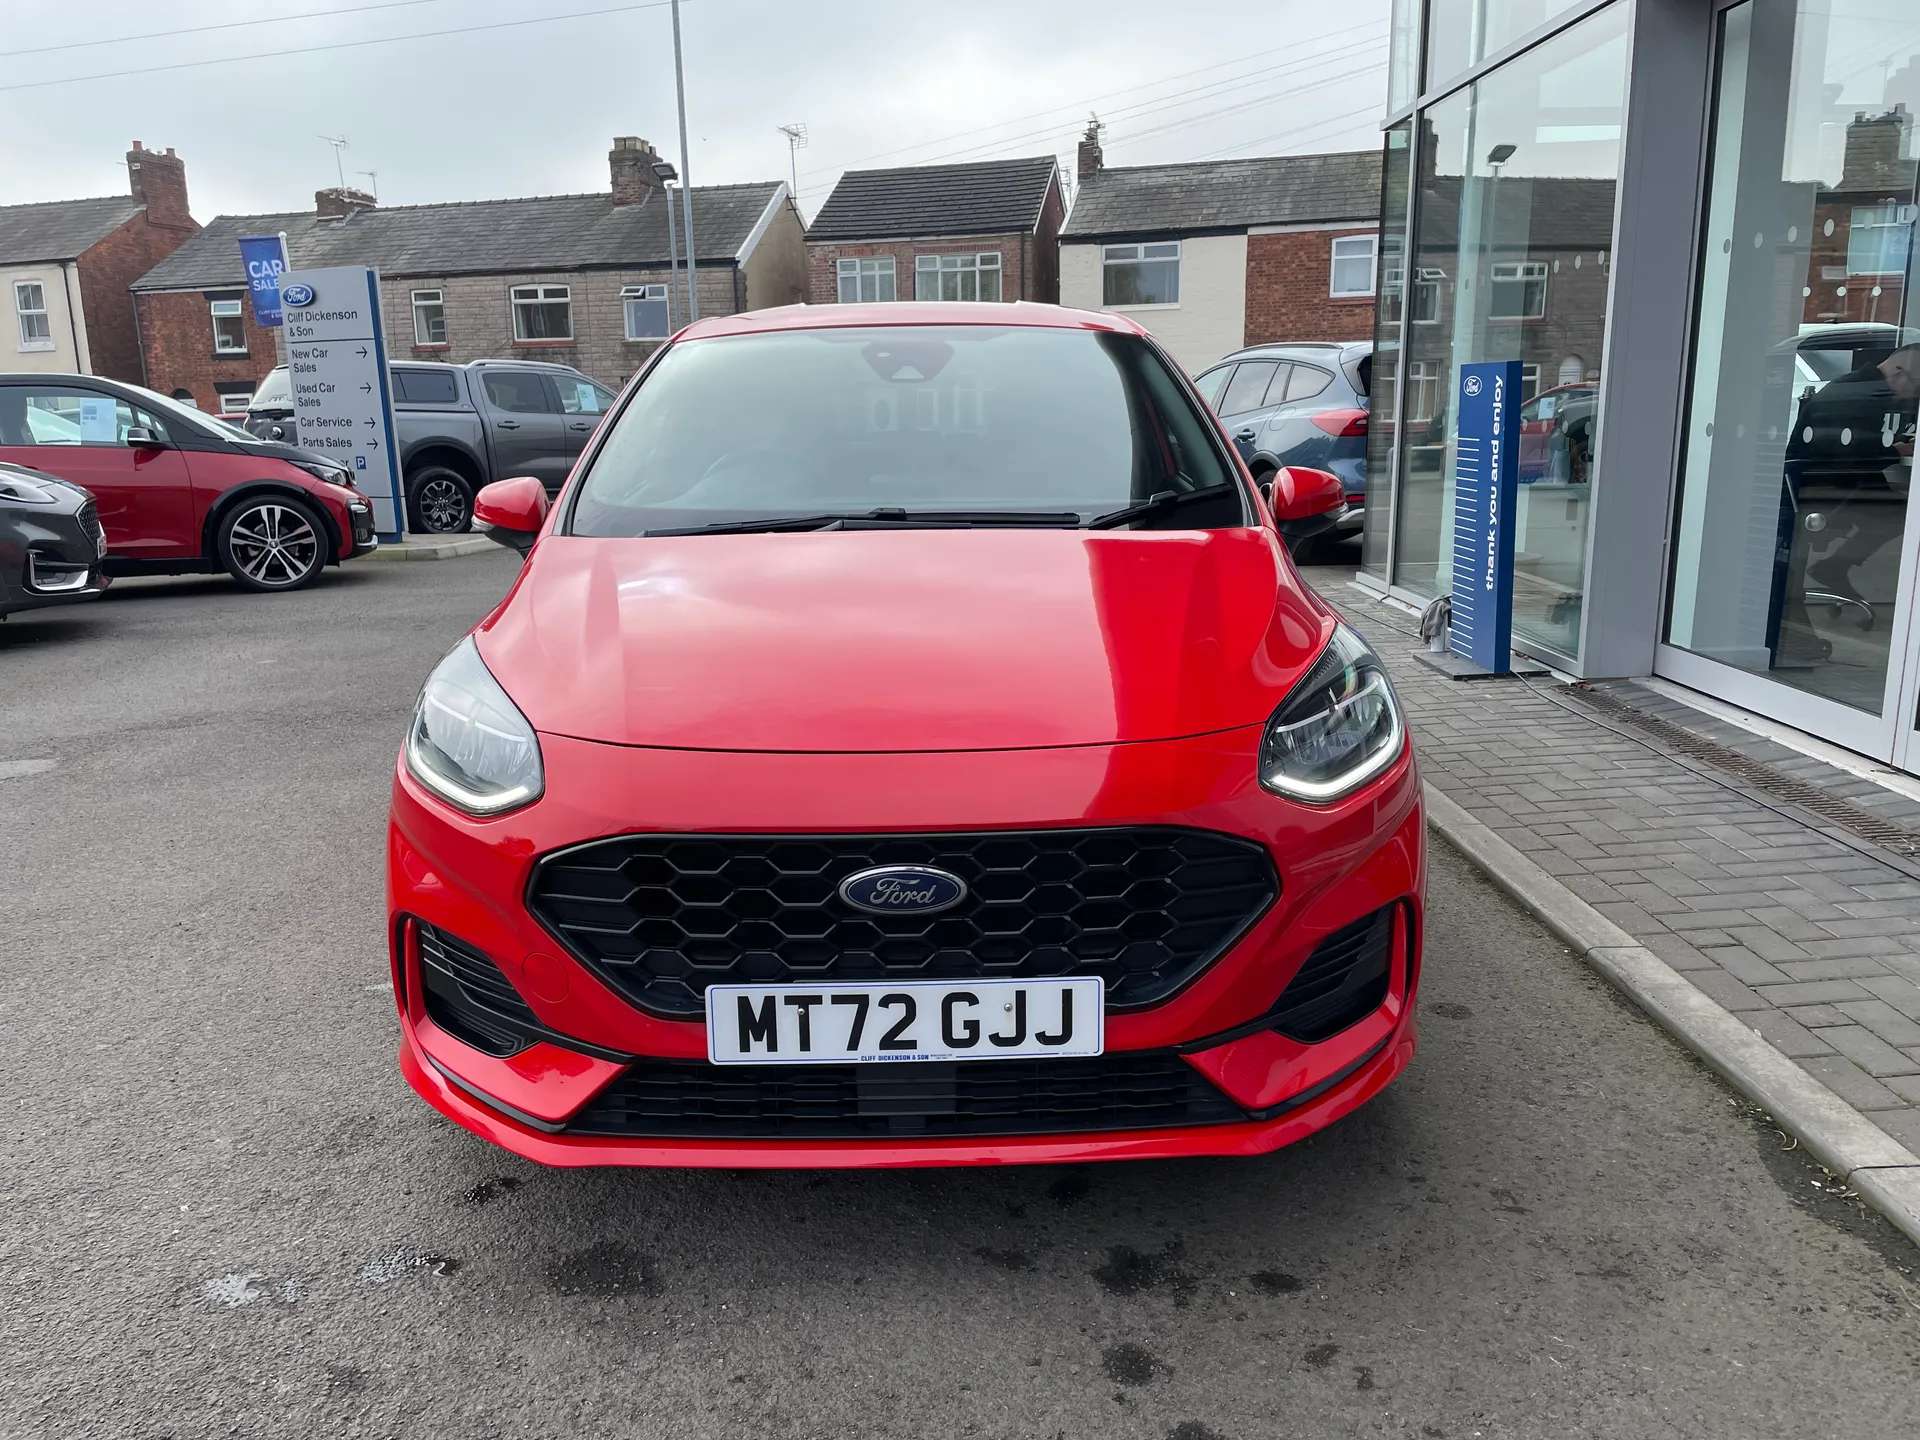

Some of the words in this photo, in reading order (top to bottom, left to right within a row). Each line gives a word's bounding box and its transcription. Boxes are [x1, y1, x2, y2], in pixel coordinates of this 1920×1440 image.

[249, 260, 282, 278] CAR
[253, 279, 279, 291] SALE
[287, 287, 306, 302] Ford
[287, 312, 304, 323] Cliff
[305, 310, 358, 322] Dickenson
[289, 327, 296, 337] &
[297, 326, 313, 337] Son
[292, 349, 310, 359] New
[312, 347, 328, 358] Car
[294, 362, 317, 373] Sales
[296, 383, 317, 394] Used
[319, 382, 335, 393] Car
[1466, 378, 1480, 393] Ford
[298, 397, 321, 408] Sales
[1492, 375, 1503, 435] enjoy
[300, 417, 315, 427] Car
[316, 417, 352, 427] Service
[302, 437, 324, 447] Parts
[326, 437, 352, 447] Sales
[1491, 440, 1500, 482] and
[1489, 486, 1498, 525] you
[1486, 529, 1496, 591] thank
[870, 877, 937, 904] Ford
[737, 993, 918, 1053] MT72
[941, 988, 1073, 1049] GJJ
